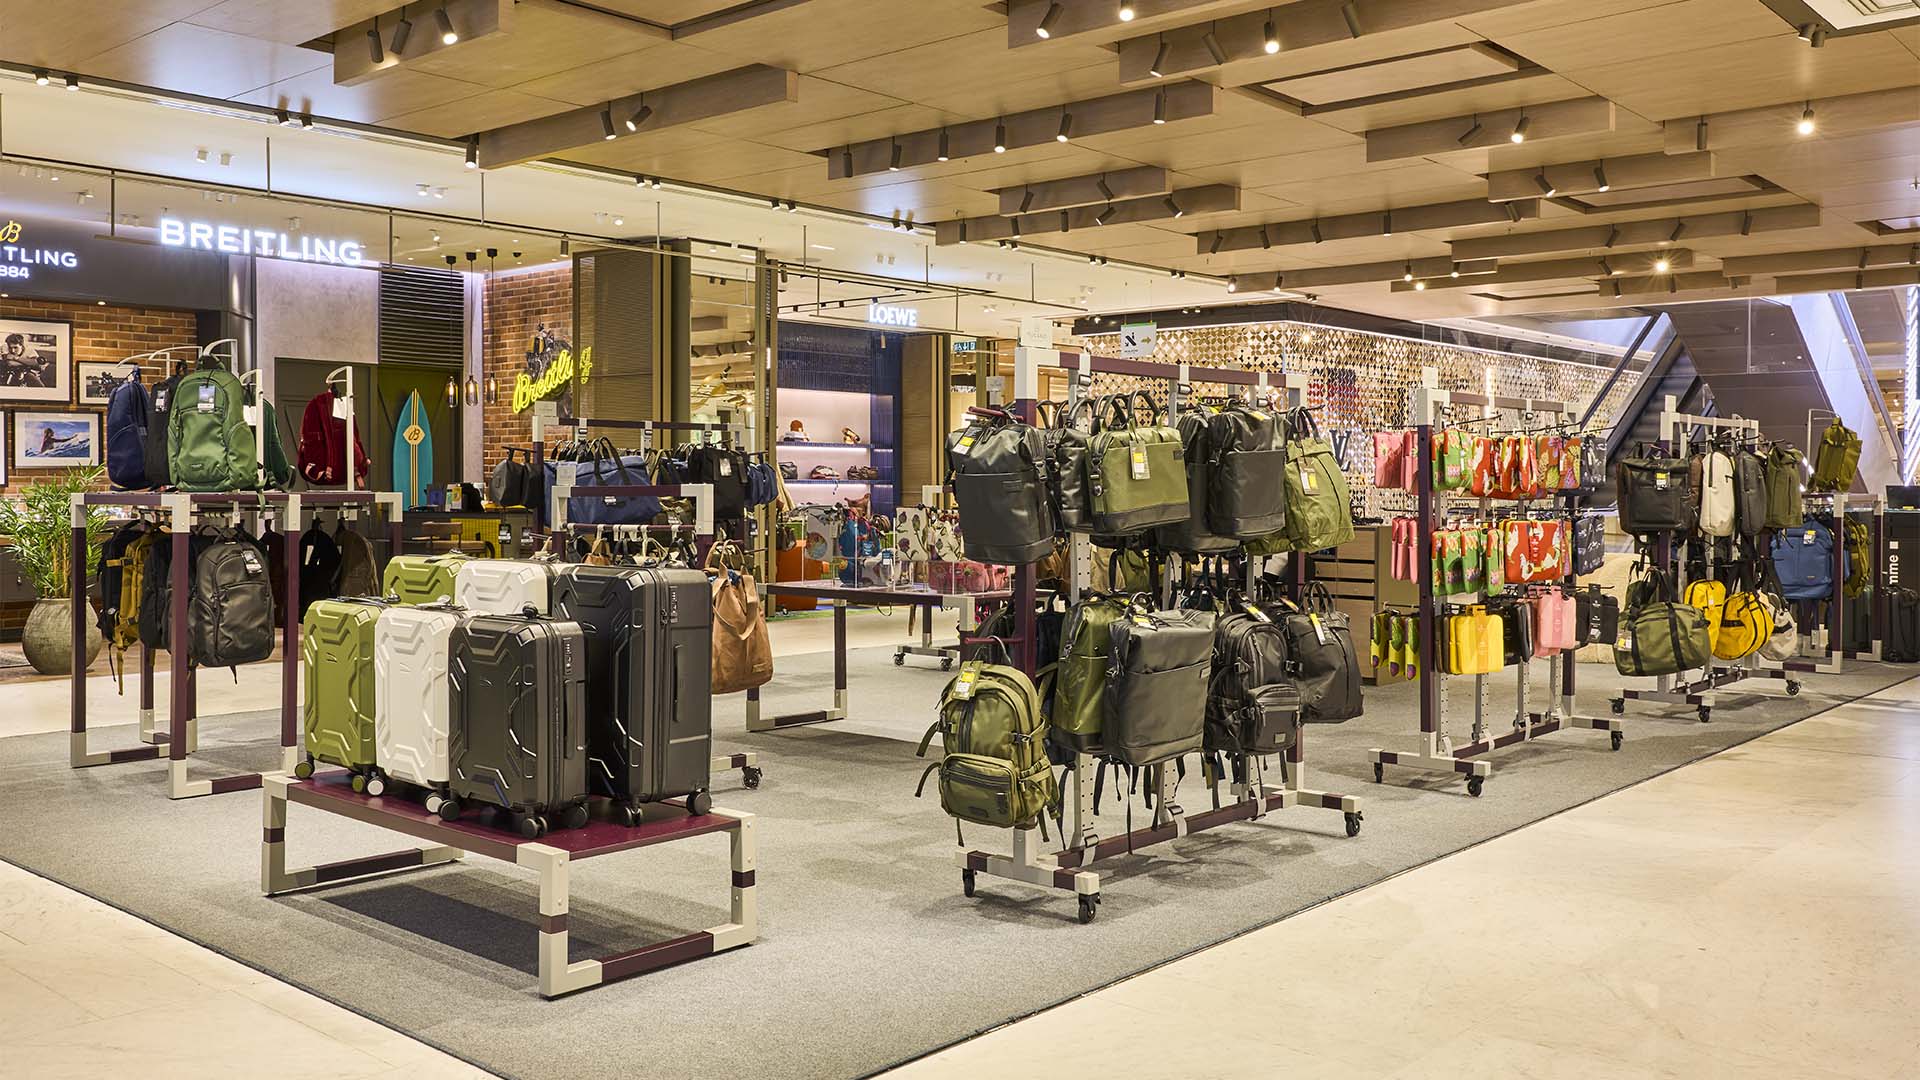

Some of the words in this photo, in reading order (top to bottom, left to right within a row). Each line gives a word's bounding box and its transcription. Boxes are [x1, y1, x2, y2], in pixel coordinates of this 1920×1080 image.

[0, 246, 78, 268] TLING
[160, 218, 363, 266] BREITLING
[869, 303, 917, 326] LOEWE
[513, 346, 592, 414] Breitlig
